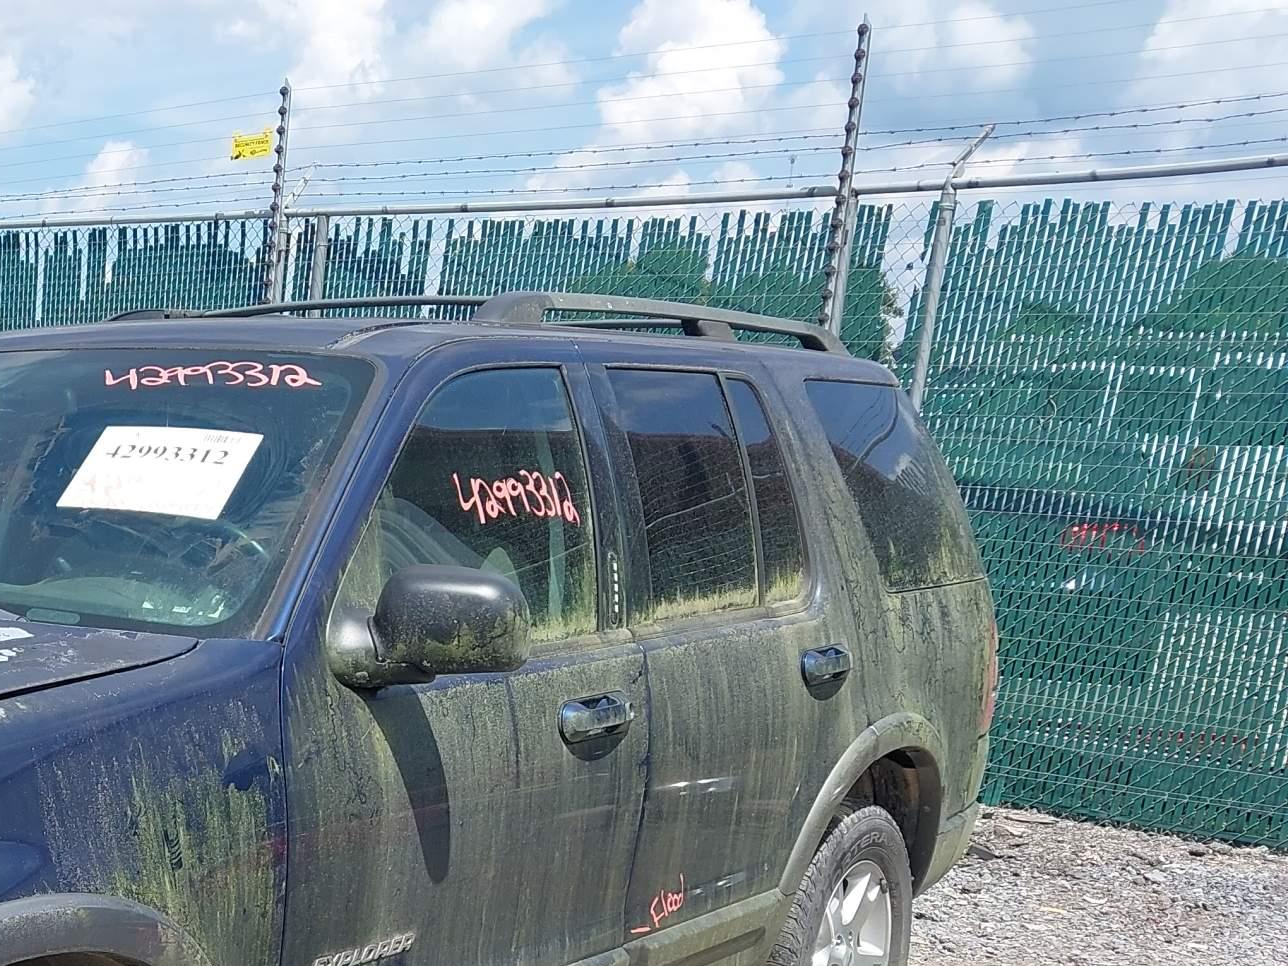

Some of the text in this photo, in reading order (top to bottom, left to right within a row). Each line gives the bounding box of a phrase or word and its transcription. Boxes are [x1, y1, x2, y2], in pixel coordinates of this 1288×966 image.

[105, 361, 321, 390] 42993312
[106, 442, 229, 465] 42993312
[452, 470, 580, 526] 42993312
